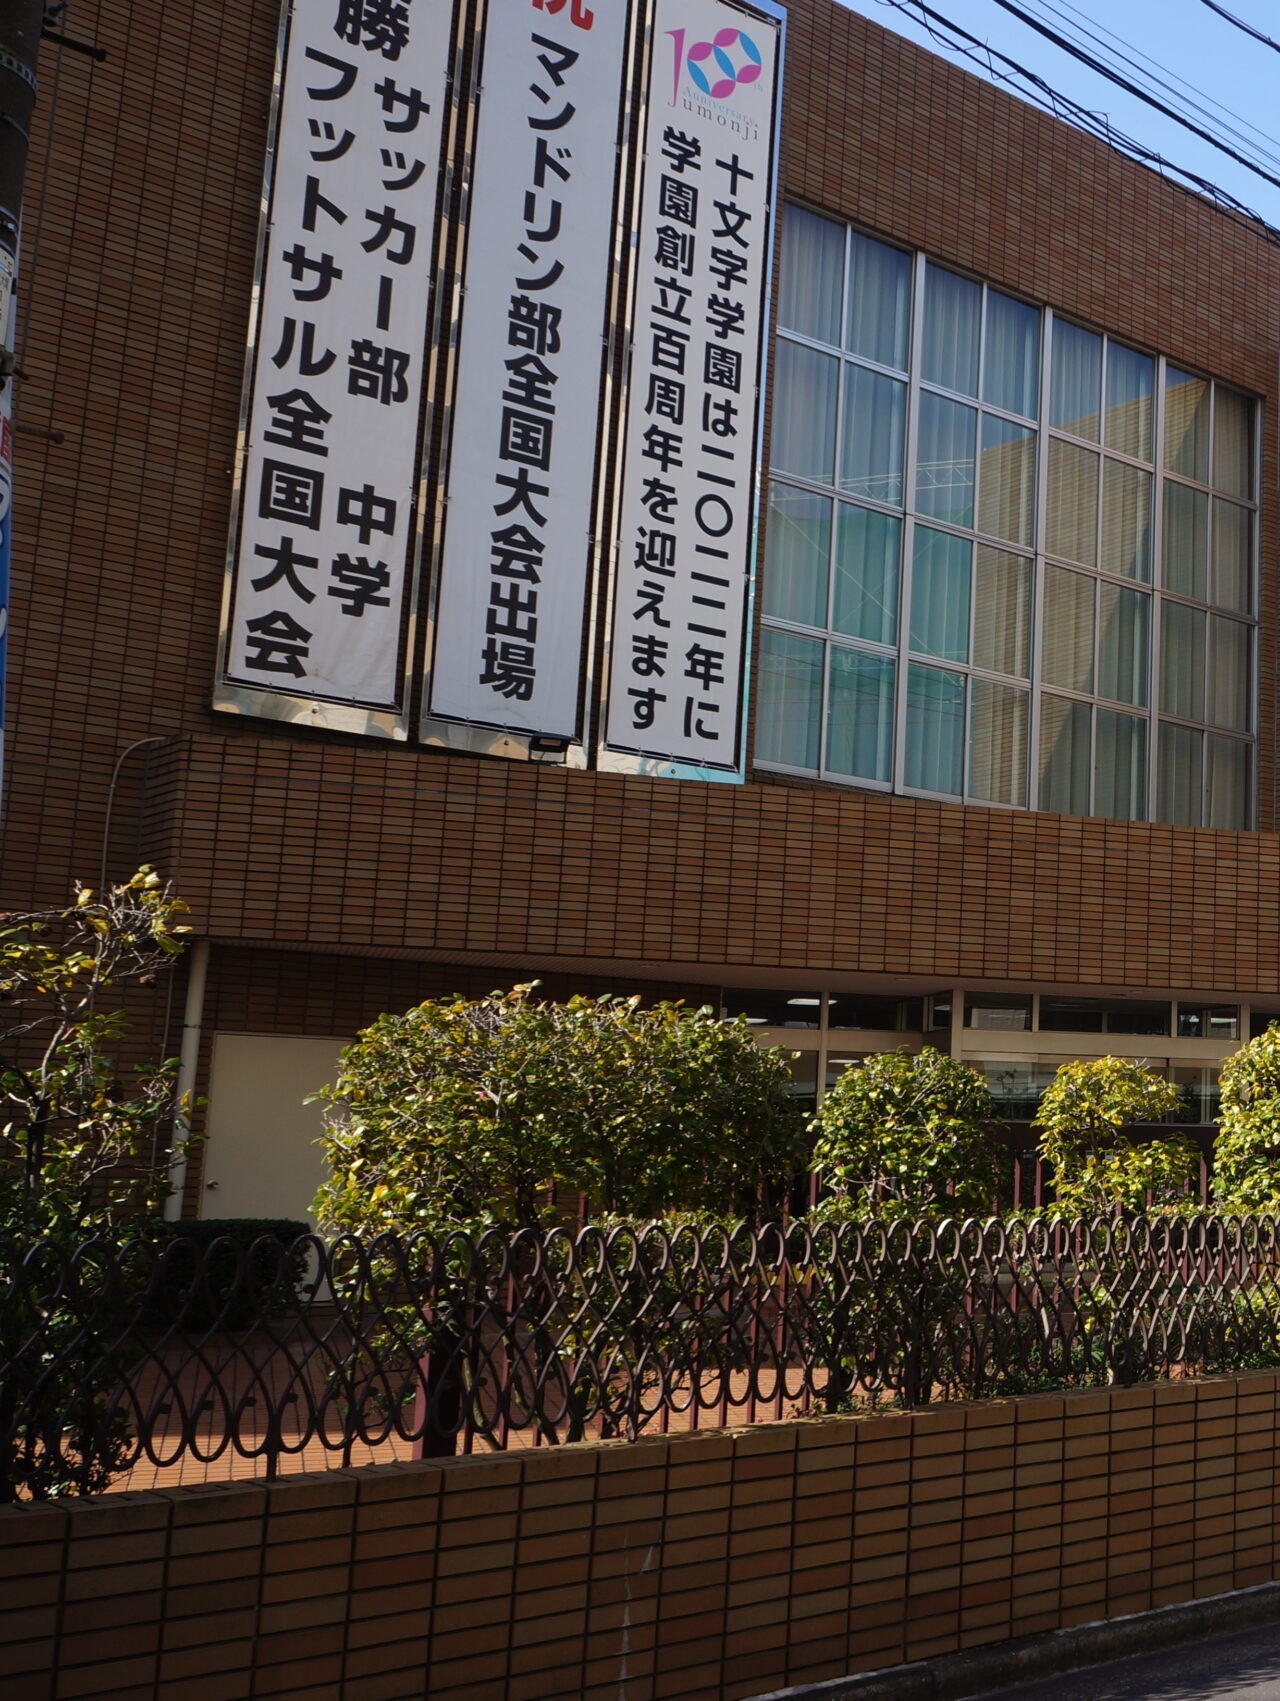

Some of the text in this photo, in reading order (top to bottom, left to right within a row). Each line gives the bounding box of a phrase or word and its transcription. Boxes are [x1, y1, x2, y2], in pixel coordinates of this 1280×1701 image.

[244, 46, 359, 679] フットサル全国大会
[327, 76, 431, 618] サッカー部 中学
[479, 32, 580, 702] マンドリン部全国大会出場
[627, 125, 701, 730] 学園創立百周年を迎えます
[683, 153, 754, 741] 十文字学園は二〇二二年に
